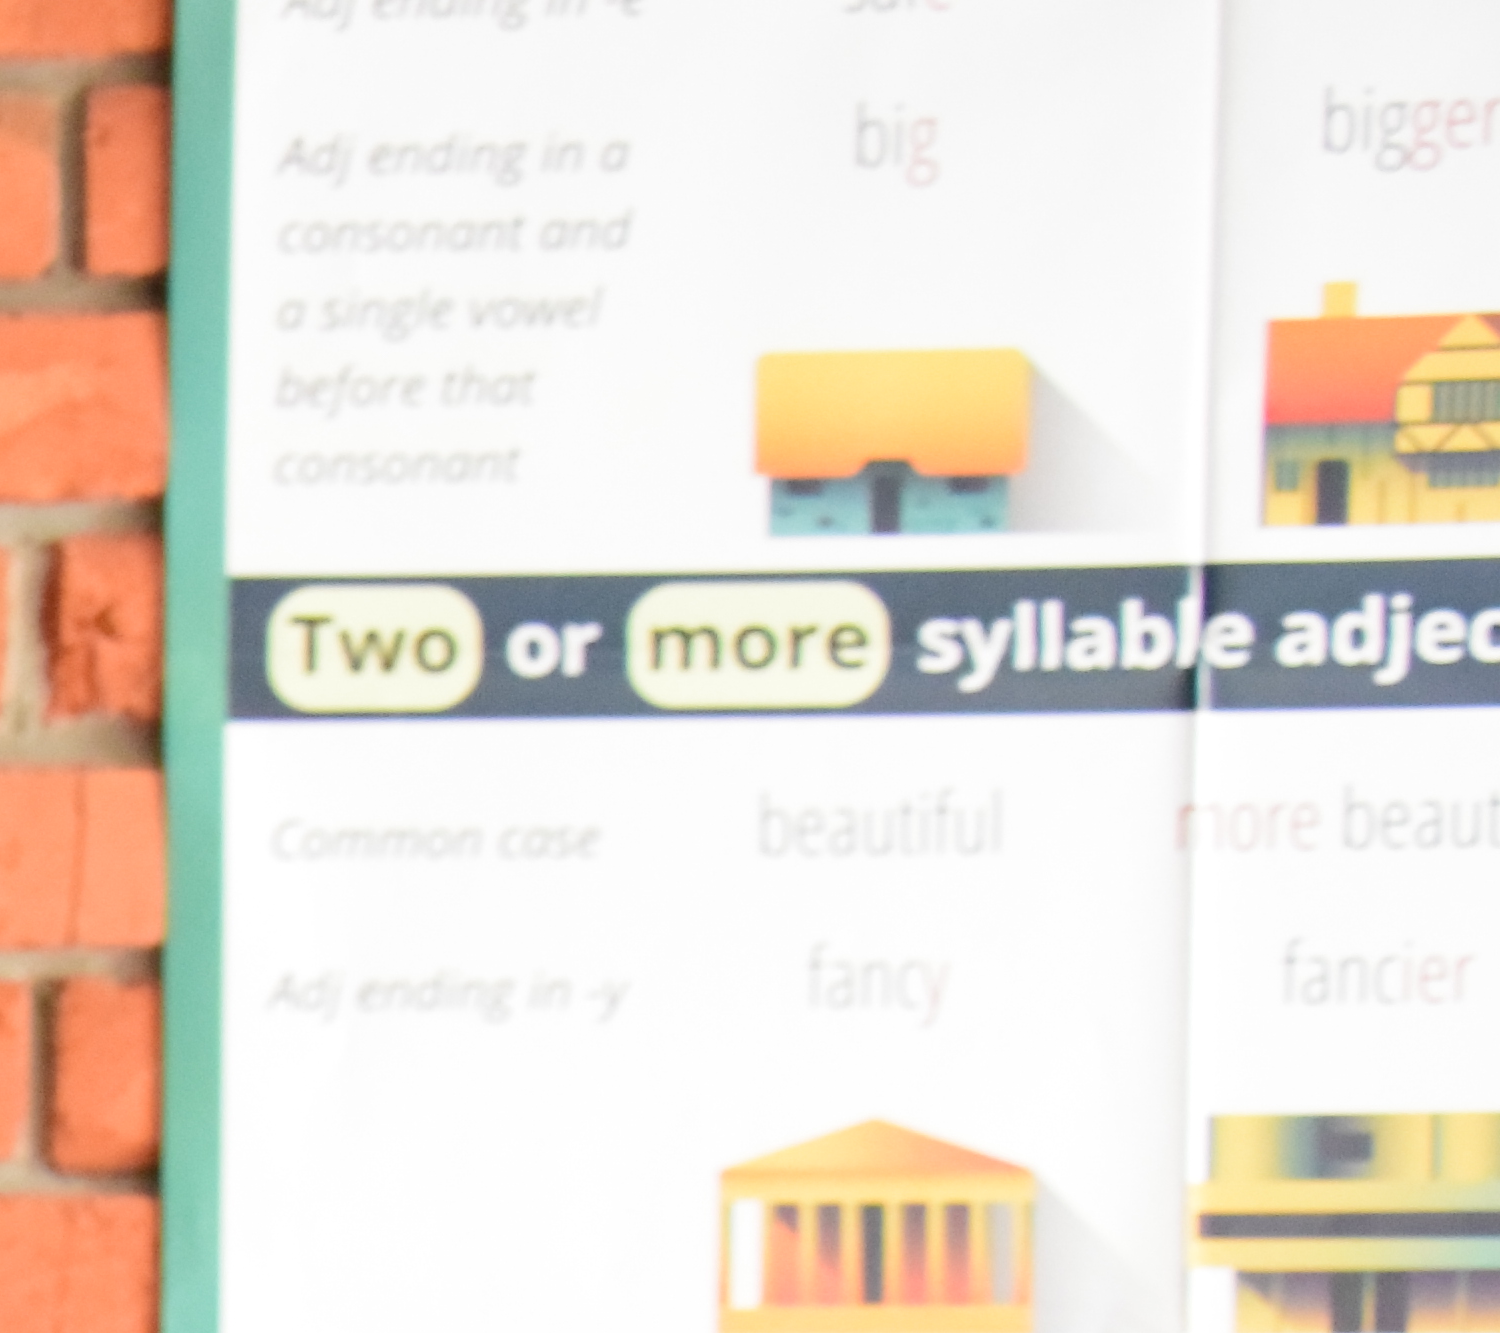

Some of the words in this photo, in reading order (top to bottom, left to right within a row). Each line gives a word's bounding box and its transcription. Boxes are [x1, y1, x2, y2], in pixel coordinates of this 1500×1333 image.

[855, 101, 940, 187] big
[1322, 83, 1500, 172] bigger
[277, 134, 351, 189] Adj
[369, 137, 527, 185] ending
[539, 136, 582, 172] in
[599, 139, 630, 172] a
[277, 216, 526, 254] consonant
[539, 210, 633, 252] and
[276, 300, 304, 331] a
[321, 290, 452, 342] single
[470, 287, 604, 331] vowel
[276, 365, 424, 418] before
[440, 370, 535, 407] that
[273, 447, 520, 486] consonant
[289, 614, 459, 674] Two
[505, 622, 602, 678] or
[649, 622, 870, 672] more
[916, 594, 1255, 693] syllable
[1274, 592, 1500, 687] adjec
[270, 816, 482, 862] Common
[497, 823, 603, 860] case
[757, 788, 1004, 858] beautiful
[1174, 799, 1320, 852] more
[1341, 783, 1500, 851] beaut
[267, 972, 345, 1024] Adj
[357, 972, 514, 1024] ending
[528, 972, 572, 1011] in
[807, 942, 951, 1028] fancy
[1281, 936, 1476, 1006] fancier
